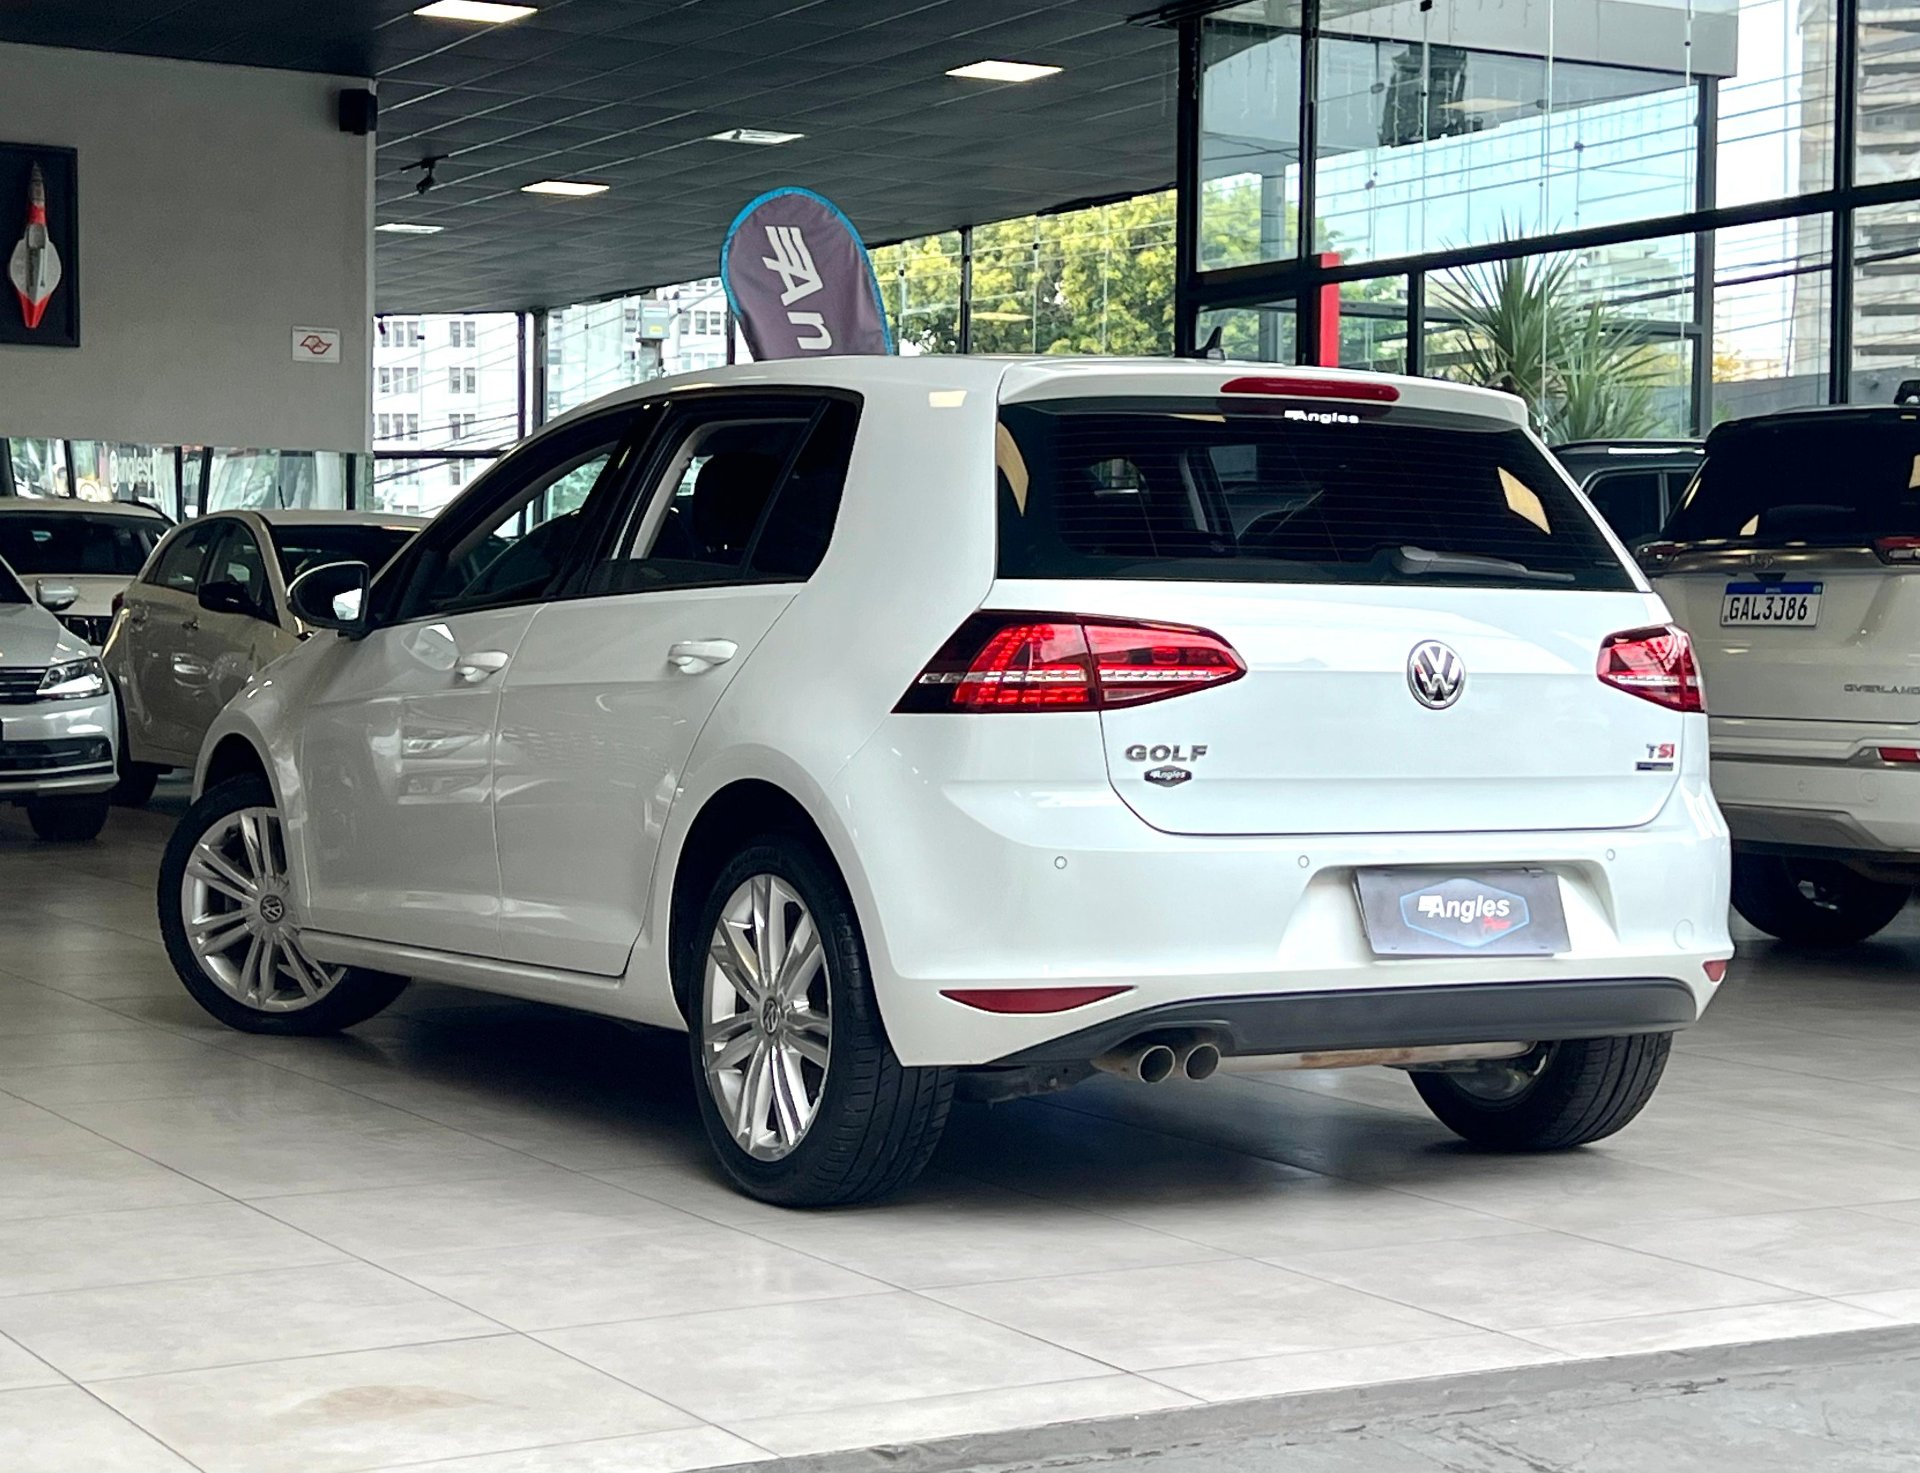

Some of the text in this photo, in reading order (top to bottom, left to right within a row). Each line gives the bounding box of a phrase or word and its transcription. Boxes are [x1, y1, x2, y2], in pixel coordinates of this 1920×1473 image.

[1284, 410, 1360, 424] Angles
[1729, 596, 1809, 621] GAL3J86
[1125, 744, 1208, 762] GOLF
[1645, 743, 1675, 759] TSI
[1418, 894, 1510, 923] Angles
